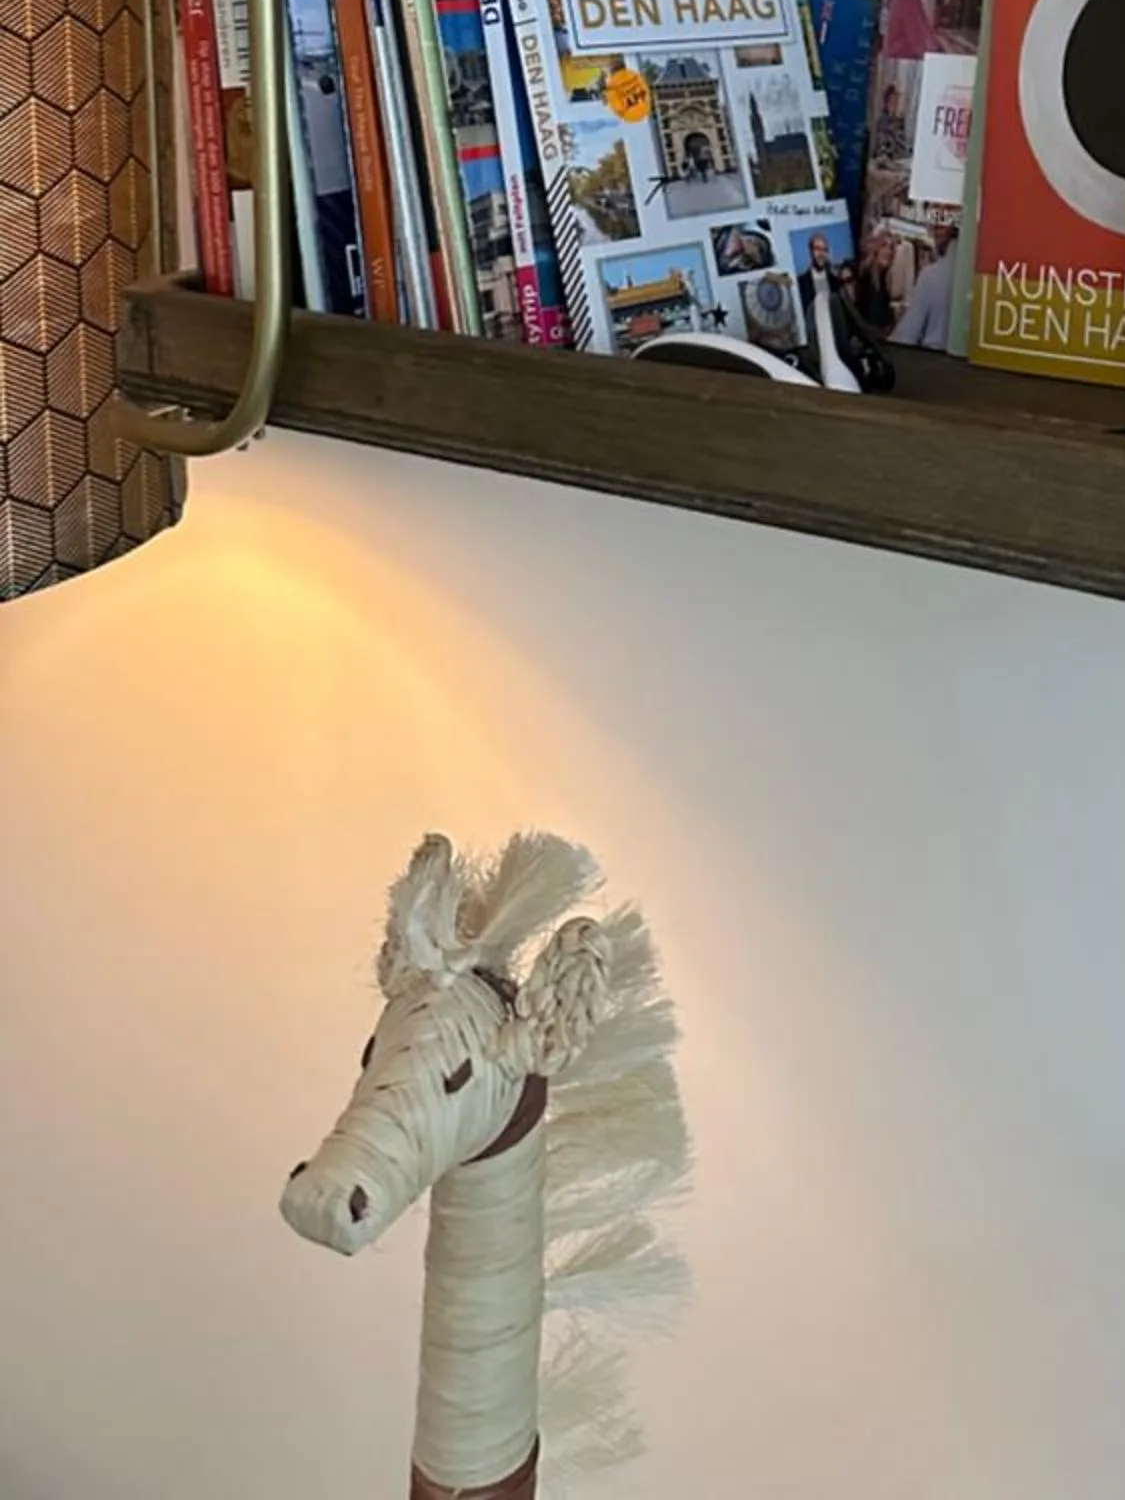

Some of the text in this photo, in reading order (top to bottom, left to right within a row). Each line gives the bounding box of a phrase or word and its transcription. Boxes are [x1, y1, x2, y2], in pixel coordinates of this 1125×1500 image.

[521, 33, 546, 87] DEN
[532, 92, 559, 162] HAAG
[993, 299, 1071, 346] DEN
